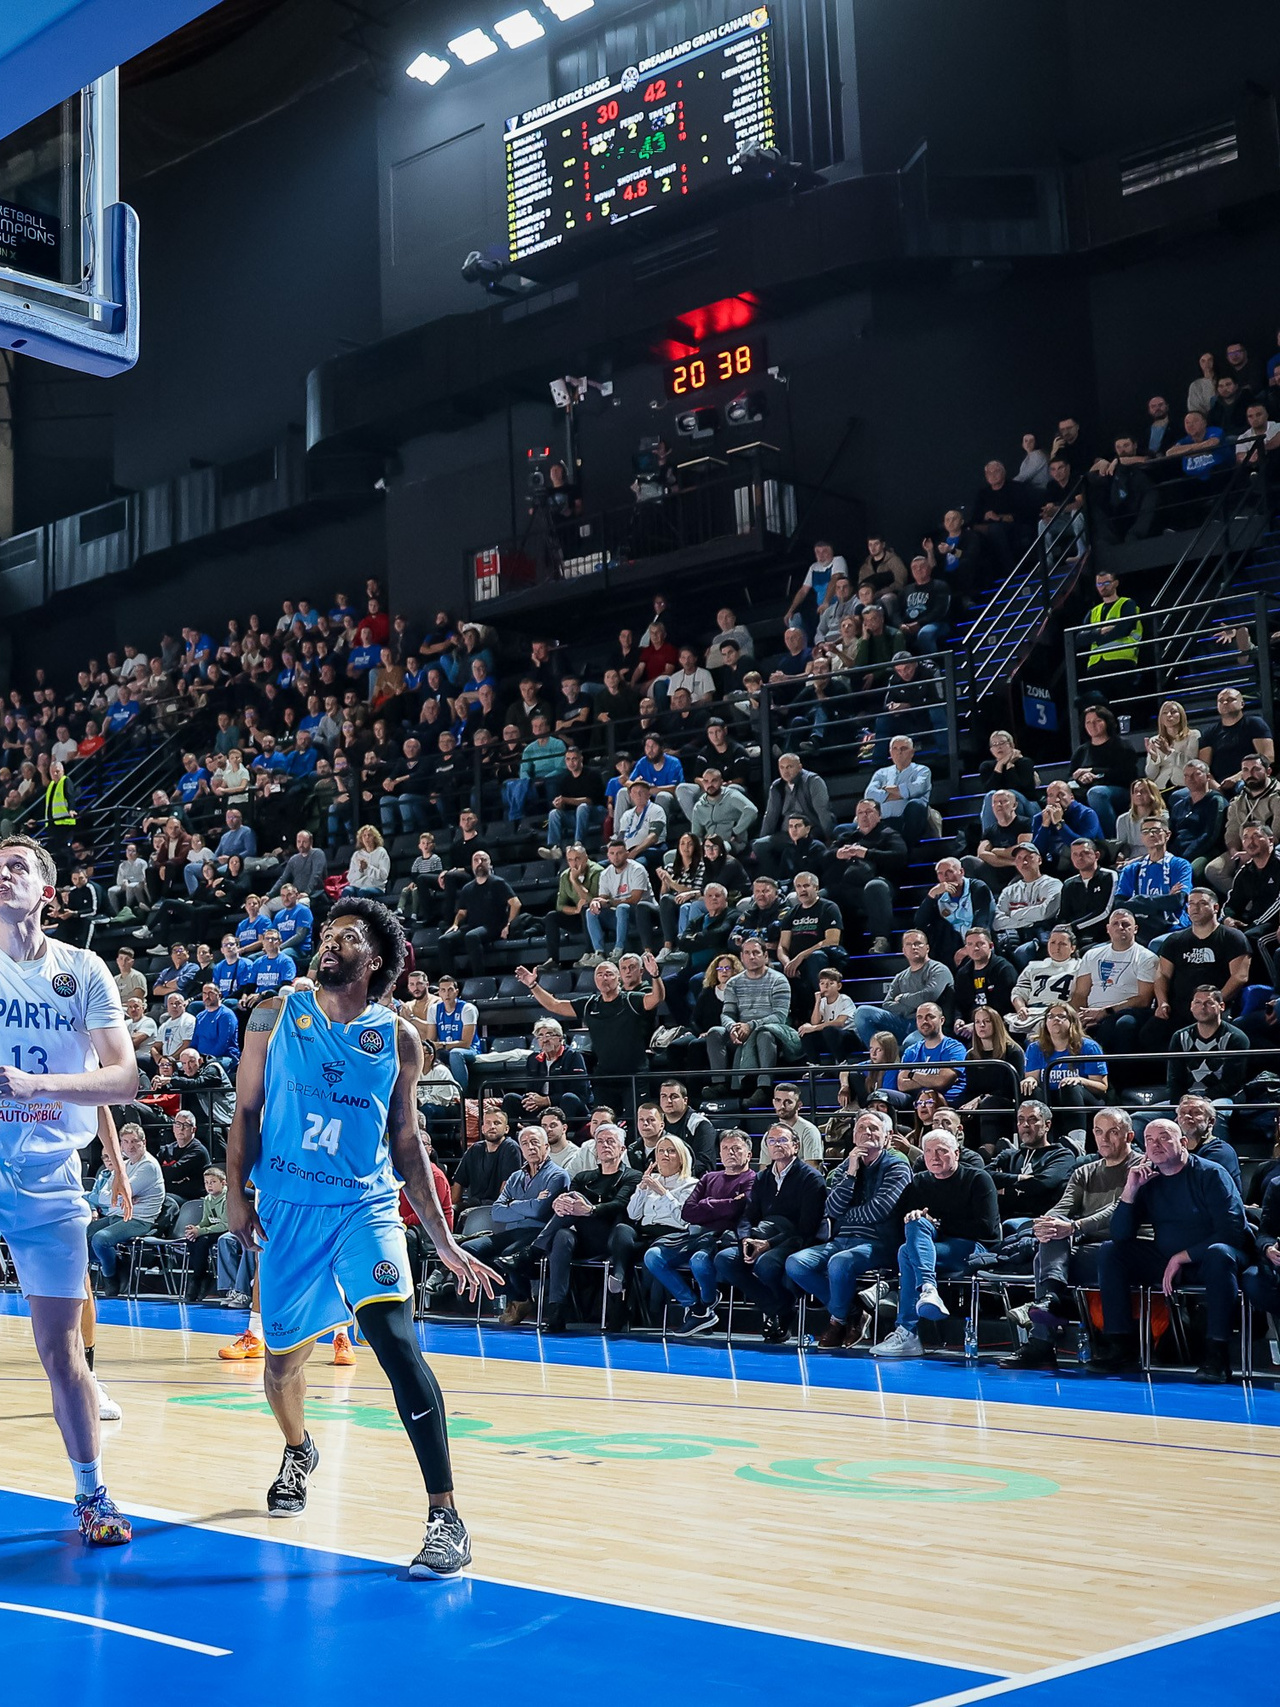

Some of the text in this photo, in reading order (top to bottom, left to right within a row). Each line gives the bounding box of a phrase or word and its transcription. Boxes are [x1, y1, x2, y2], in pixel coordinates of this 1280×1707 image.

[639, 12, 754, 73] DREAMLAND GRAN CANARI
[644, 79, 667, 102] 42
[522, 76, 610, 124] SPARTAK OFFICE SHOES
[597, 100, 619, 124] 30
[619, 112, 644, 130] PERIOD
[627, 123, 637, 139] 2
[654, 162, 677, 179] BONUS
[623, 179, 648, 201] 4.8
[661, 177, 671, 193] 2
[593, 187, 616, 204] BONUS
[601, 202, 610, 217] 5
[9, 249, 17, 260] X
[673, 345, 751, 394] 20 38
[1026, 684, 1051, 699] ZONA
[1036, 704, 1047, 725] 3
[792, 916, 819, 926] adidas
[1183, 951, 1204, 960] NORTH
[1187, 956, 1205, 964] FACE
[1033, 974, 1074, 1001] 74
[11, 1045, 49, 1074] 13
[287, 1080, 370, 1109] DREAMLAND
[301, 1112, 342, 1156] 24
[500, 1449, 603, 1465] THE
